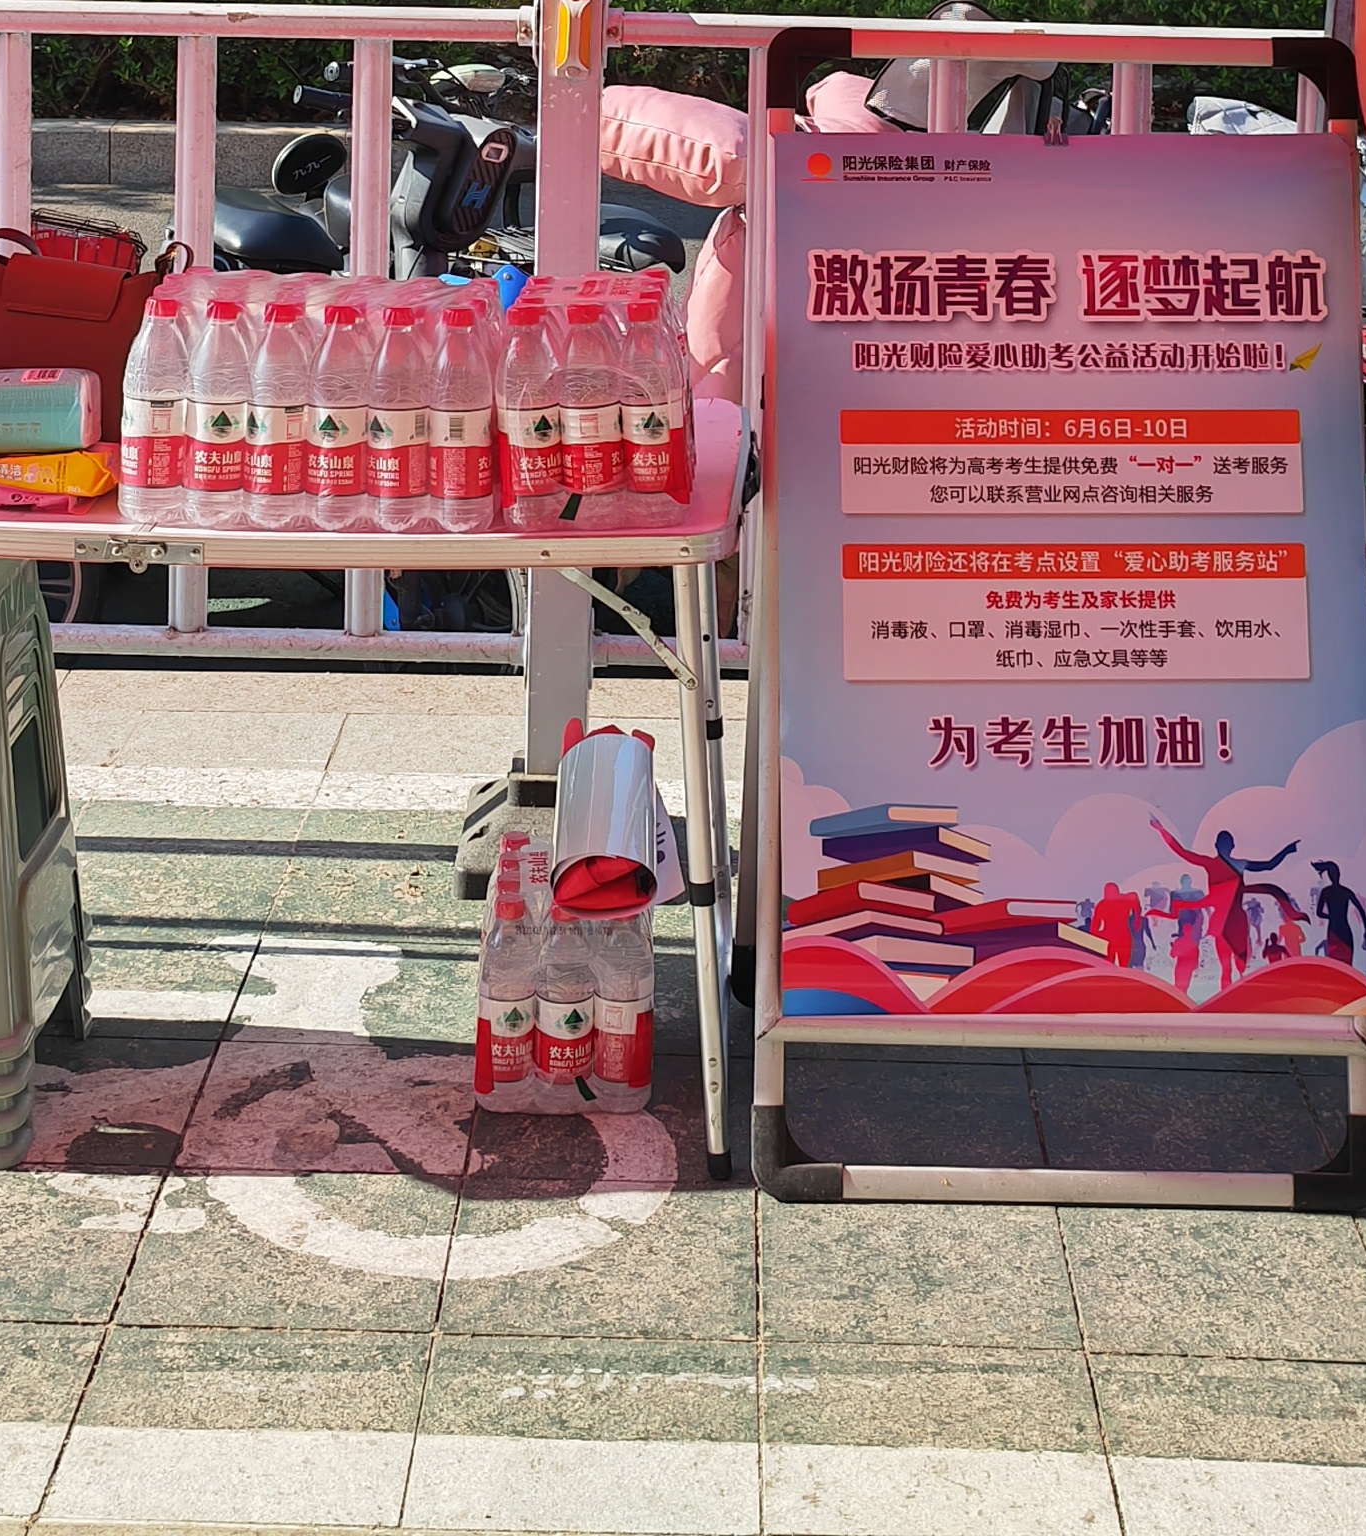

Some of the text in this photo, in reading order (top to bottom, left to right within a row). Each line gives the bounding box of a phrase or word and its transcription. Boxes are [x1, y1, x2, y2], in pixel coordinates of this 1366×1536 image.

[842, 155, 991, 172] 阳光保险集团 财产保险
[843, 174, 876, 182] Sunshine
[810, 252, 1327, 320] 激扬青春 逐梦起航
[853, 341, 1285, 371] 阳光财险爱心助考公益活动开始啦！
[307, 454, 355, 470] 农夫山泉
[929, 483, 1214, 505] 您可以联系营业网点咨询相关服务
[985, 589, 1177, 611] 免费为考生及家长提供
[995, 647, 1169, 669] 纸巾、应急文具等等
[927, 714, 1237, 771] 为考生加油！
